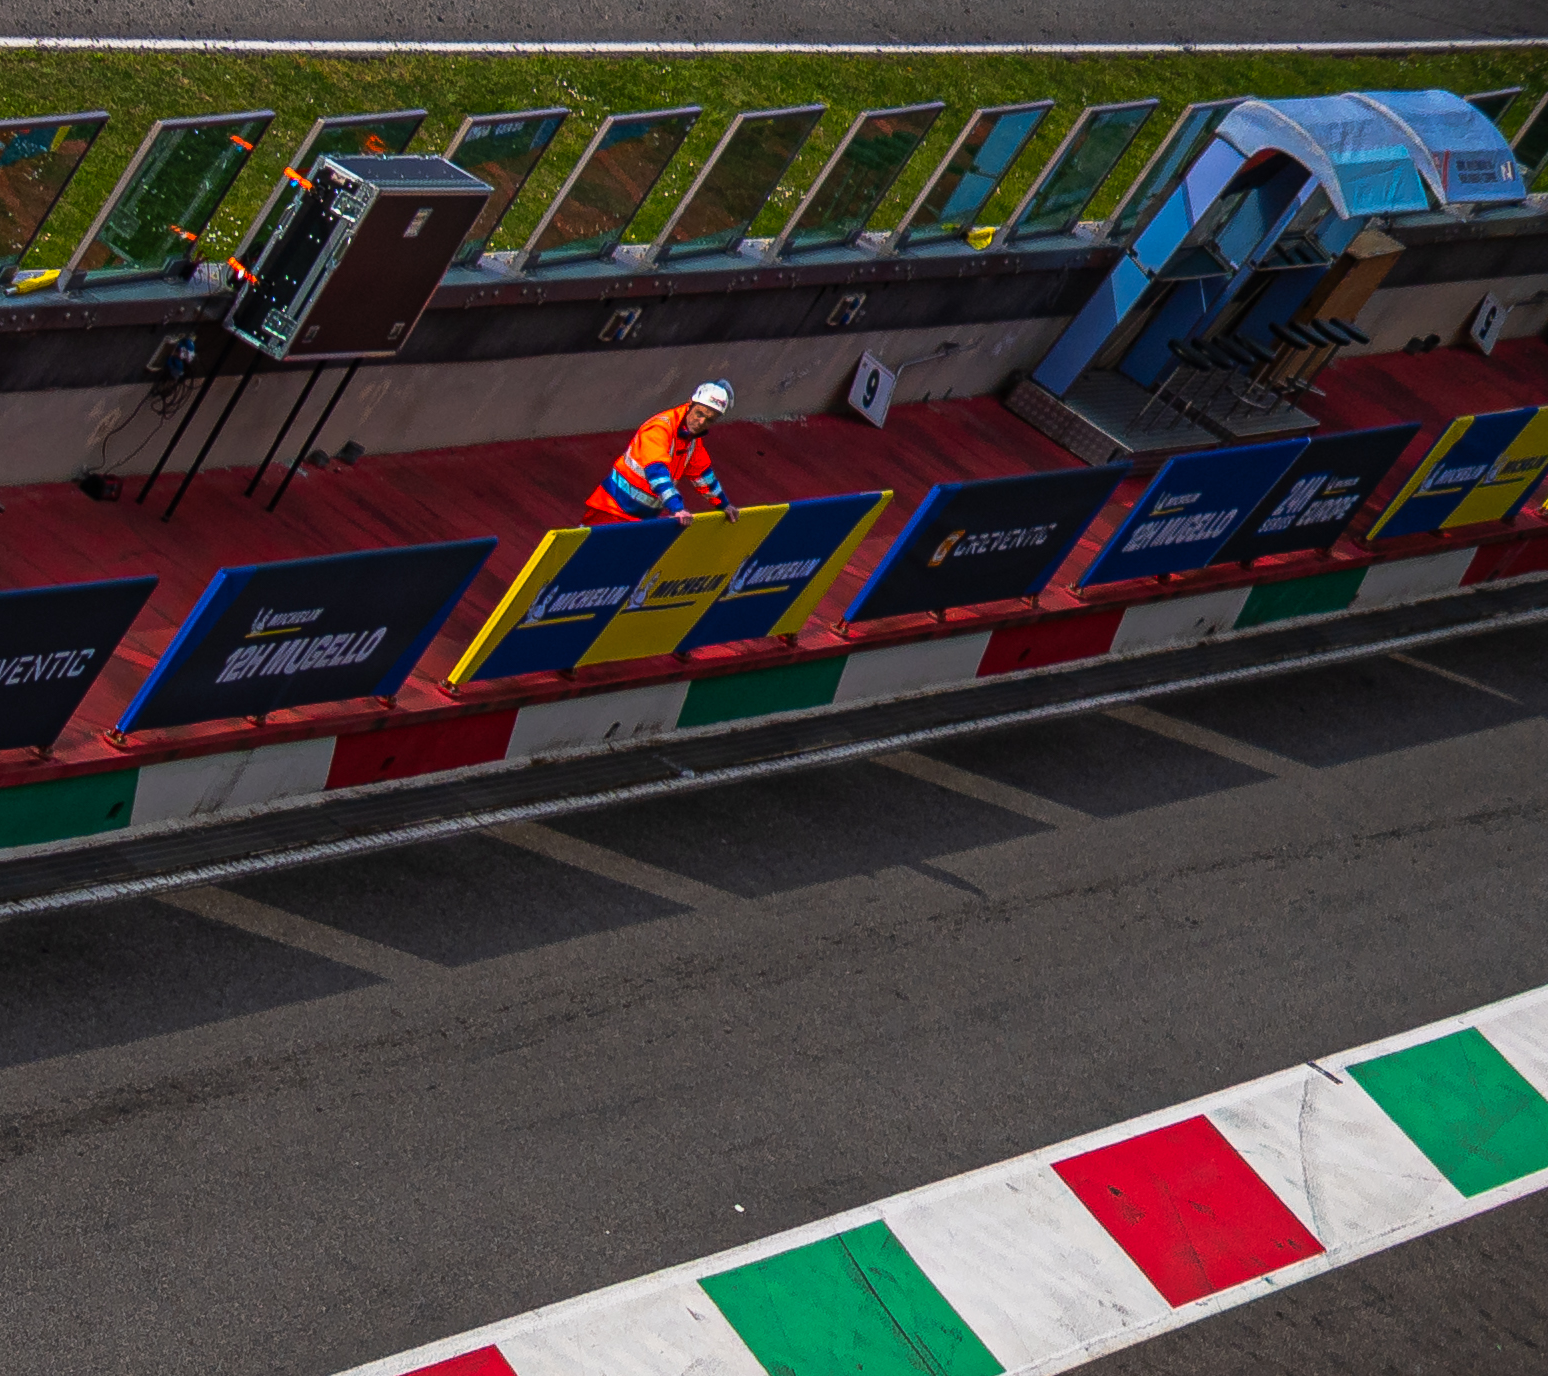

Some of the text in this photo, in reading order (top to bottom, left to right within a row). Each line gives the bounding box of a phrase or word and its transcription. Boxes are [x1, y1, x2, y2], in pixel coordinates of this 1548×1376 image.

[547, 585, 630, 613] MICHELIN
[216, 627, 388, 684] 12H MUGELLO
